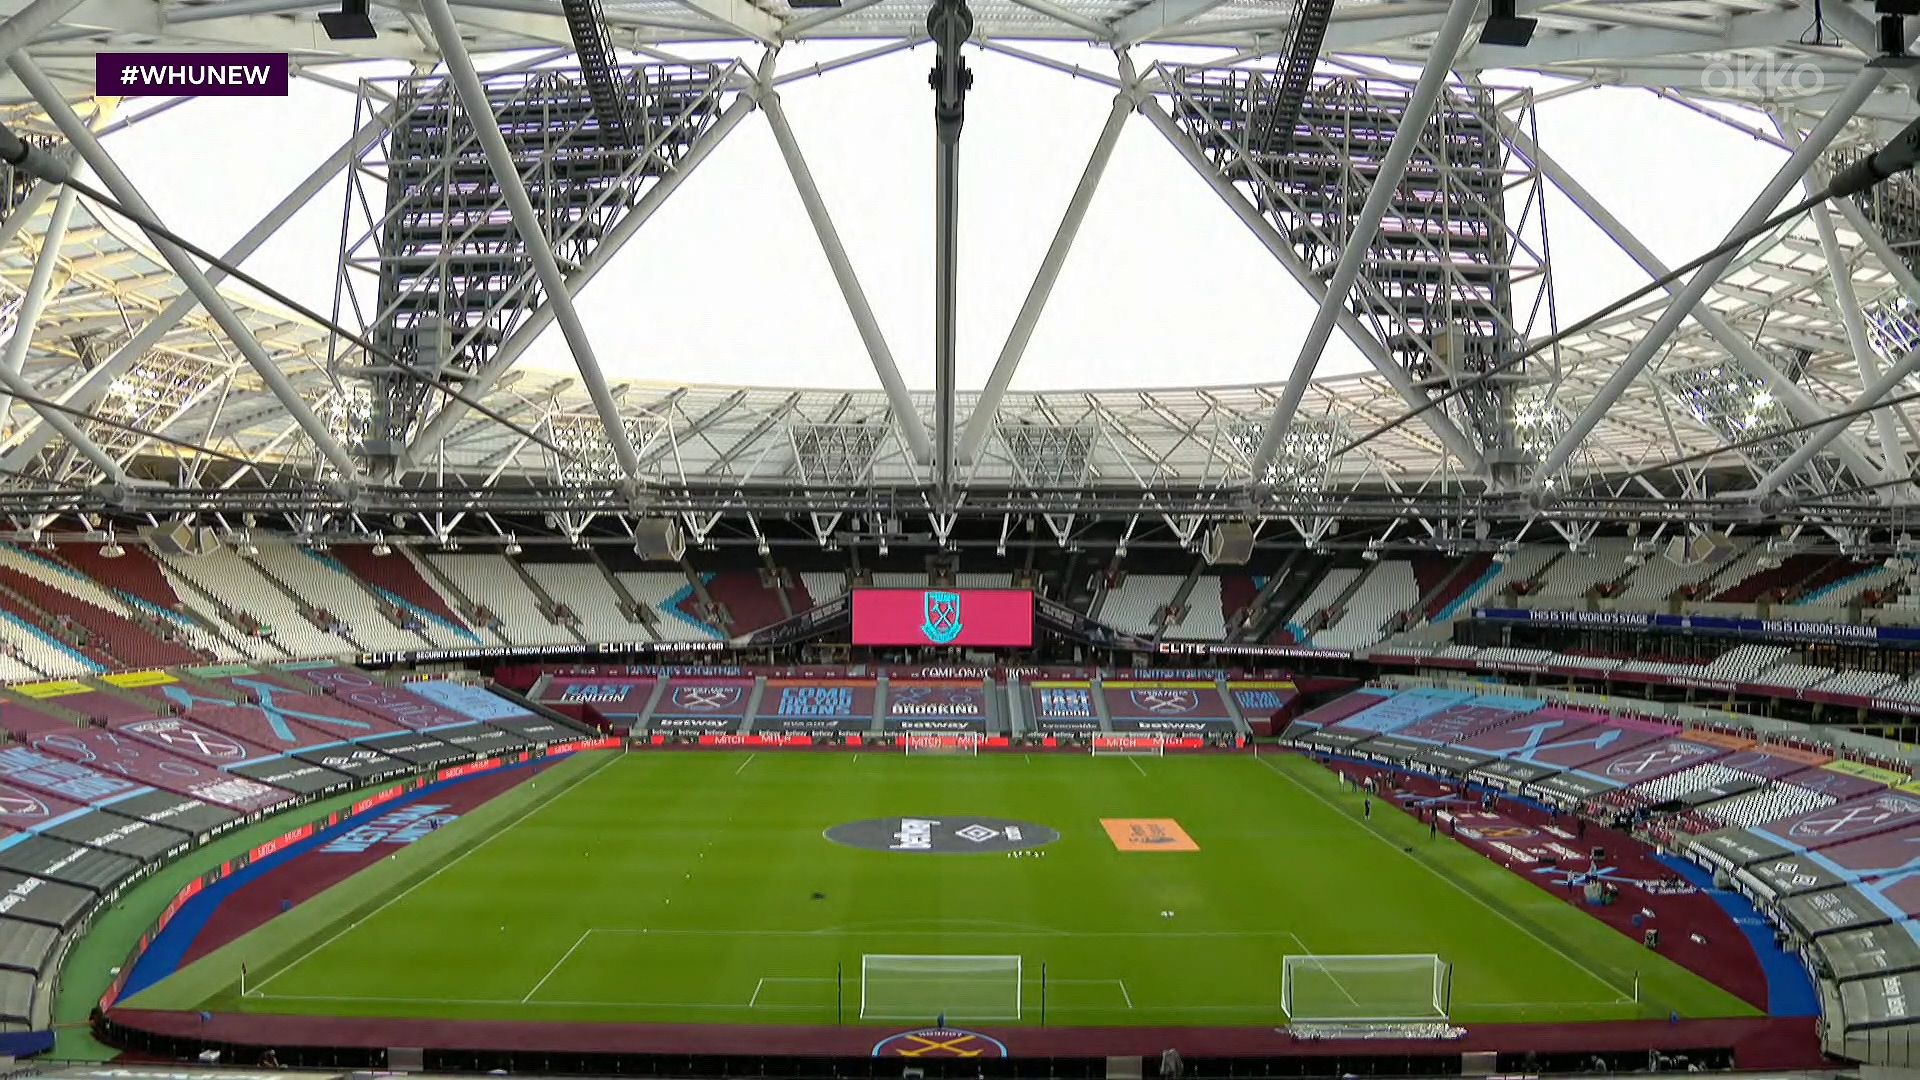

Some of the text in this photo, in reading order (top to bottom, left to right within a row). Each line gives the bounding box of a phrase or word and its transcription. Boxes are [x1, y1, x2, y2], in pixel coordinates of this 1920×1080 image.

[1529, 610, 1648, 624] THIS IS THE WORLD'S STAGE
[1762, 620, 1877, 638] THIS IS LONDON STADIUM
[600, 642, 645, 654] ELITE
[1160, 643, 1206, 654] ELITE
[1210, 646, 1237, 654] SECURITY
[1238, 647, 1264, 655] SYSTEMS
[1268, 648, 1285, 656] DOOR
[1290, 648, 1315, 657] WINDOW
[1315, 650, 1351, 659] AUTOMATION
[362, 650, 407, 664] ELITE
[416, 650, 448, 660] SECURITY
[449, 649, 480, 658] SYSTEMS
[484, 647, 505, 656] DOOR
[512, 646, 540, 655] WINDOW
[542, 645, 586, 654] AUTOMATION
[958, 666, 976, 678] ON
[566, 683, 634, 696] EAST
[561, 692, 625, 703] LONDON
[1138, 721, 1206, 730] betway
[715, 734, 745, 745] MITCH
